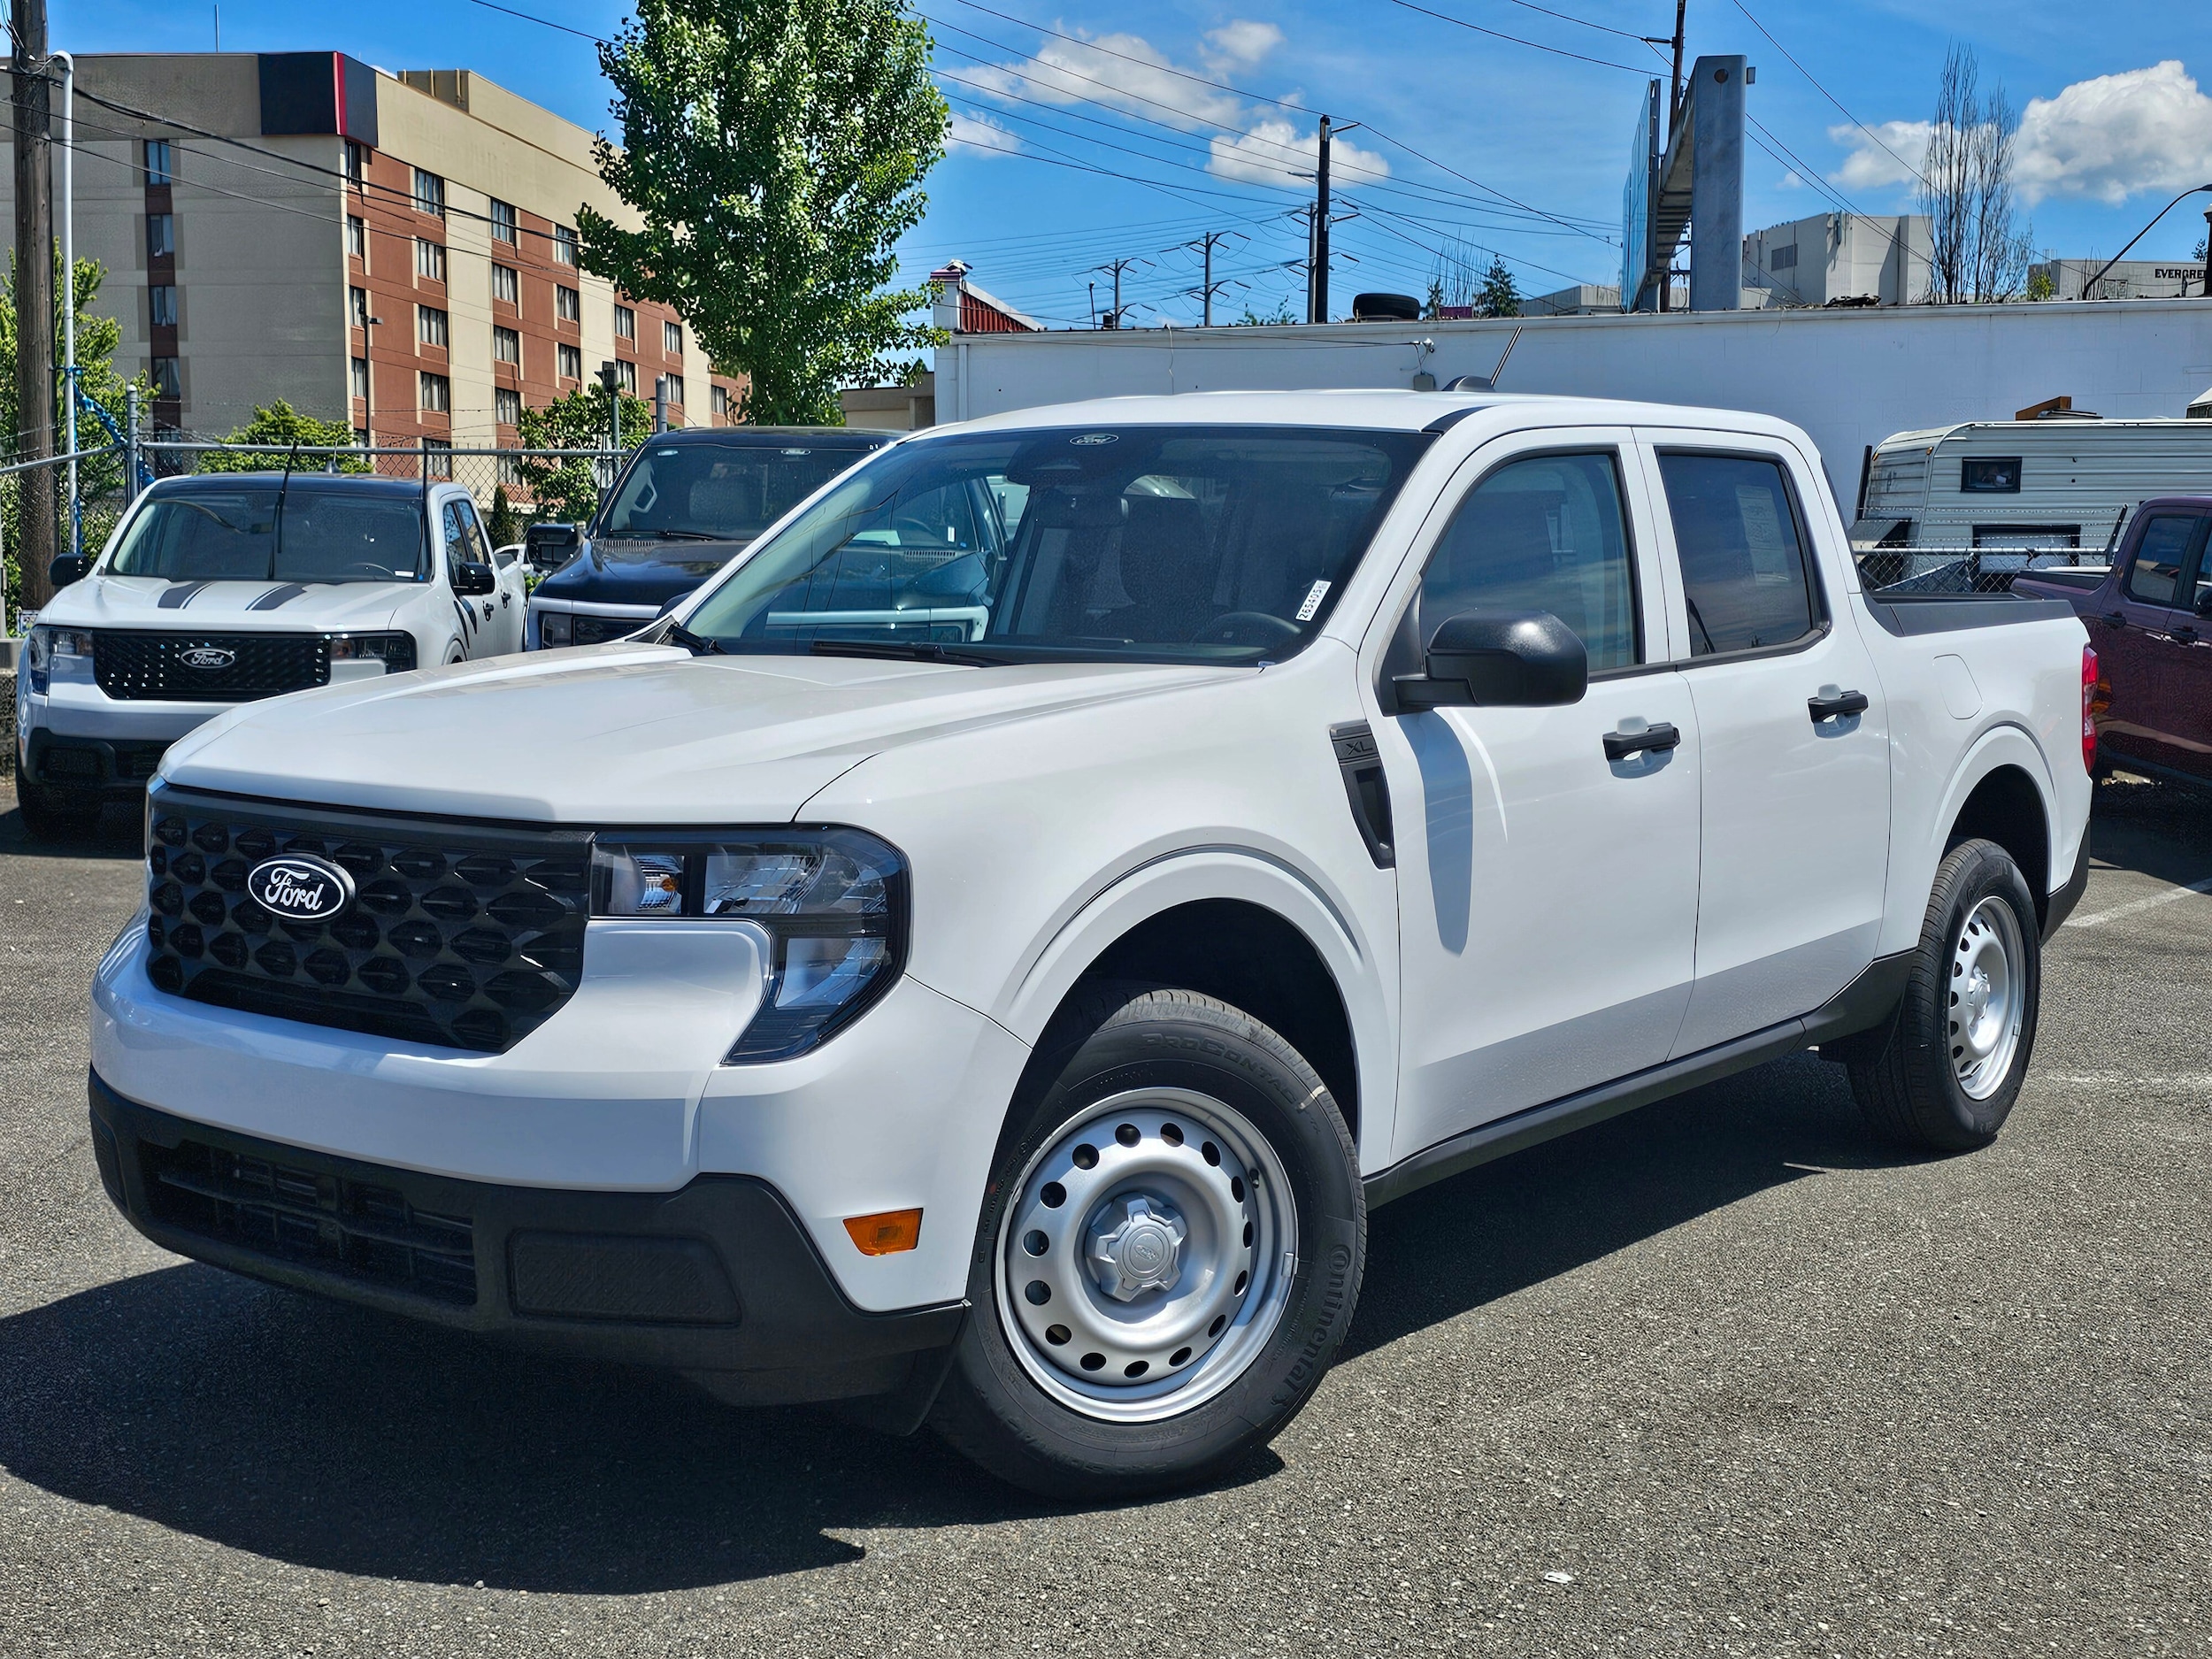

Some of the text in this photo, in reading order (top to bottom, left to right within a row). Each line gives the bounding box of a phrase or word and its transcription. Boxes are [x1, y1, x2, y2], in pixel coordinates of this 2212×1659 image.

[191, 652, 225, 664] Ford
[1346, 741, 1373, 756] XL
[265, 867, 325, 910] Ford
[1283, 1243, 1351, 1394] Continental
